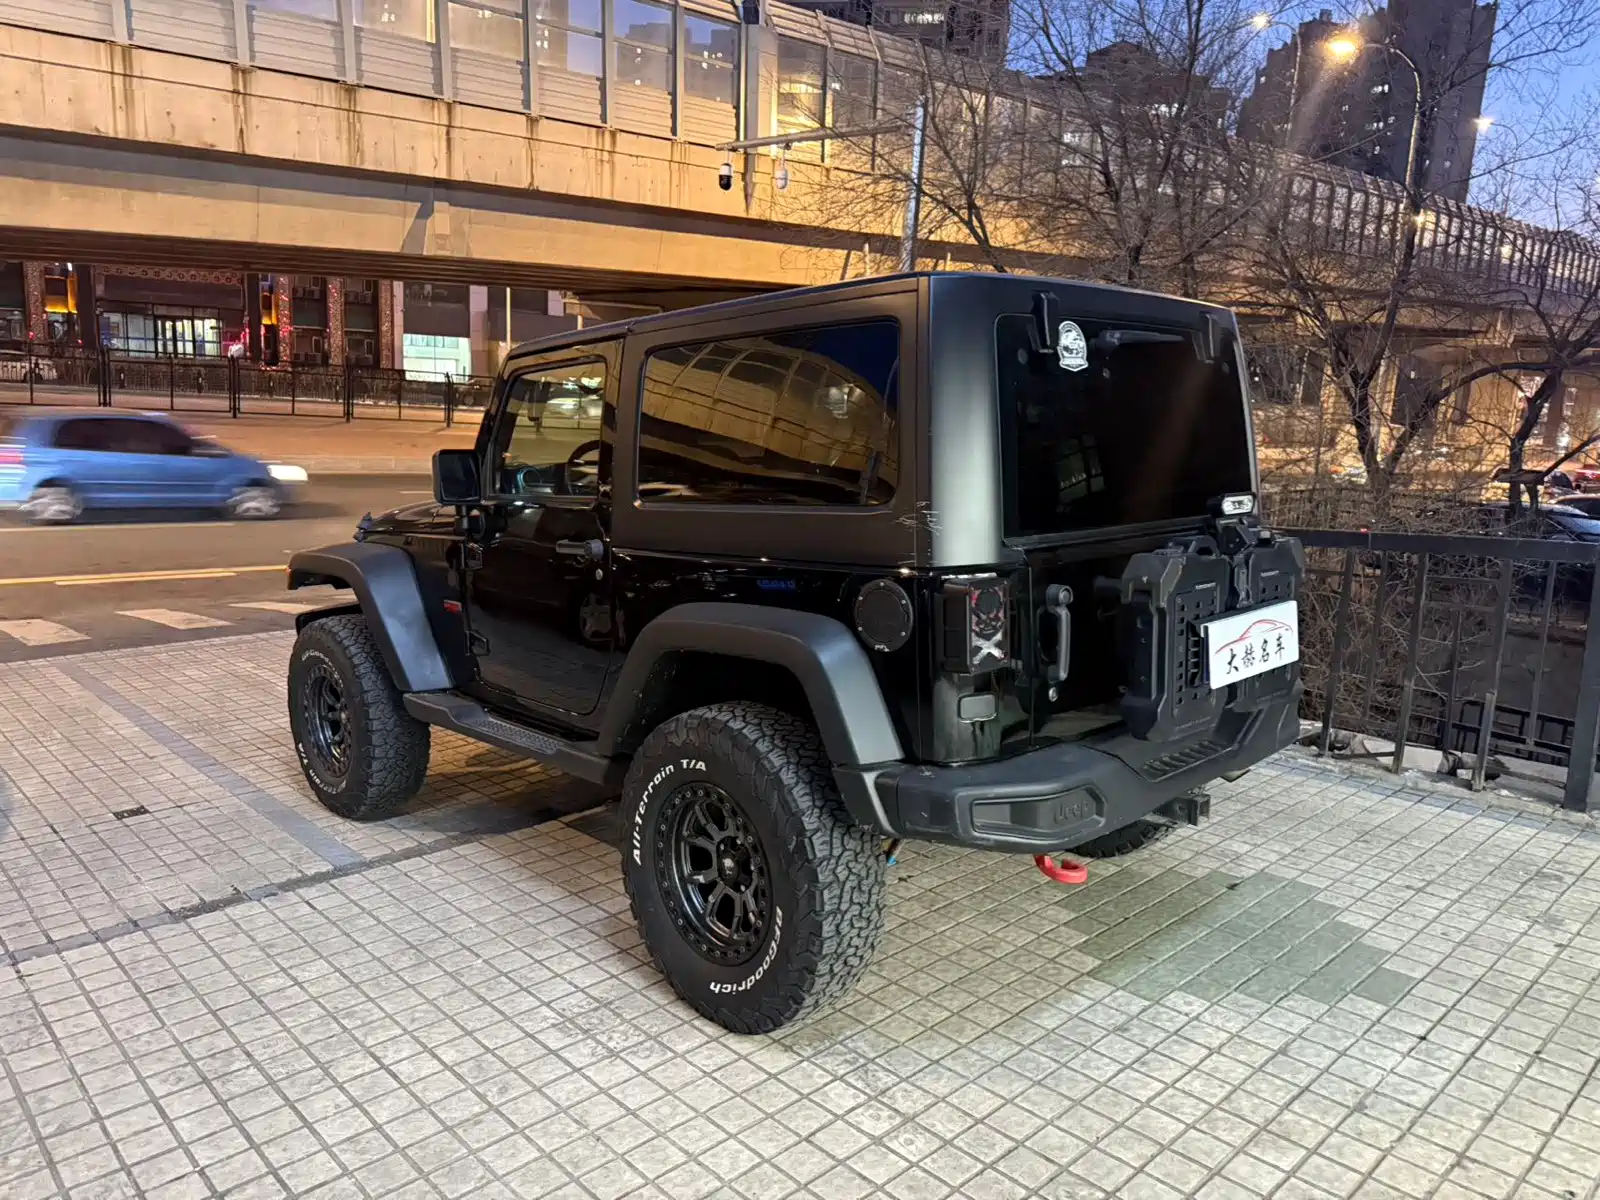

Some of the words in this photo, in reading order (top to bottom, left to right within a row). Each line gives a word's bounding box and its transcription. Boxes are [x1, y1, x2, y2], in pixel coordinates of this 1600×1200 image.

[632, 764, 675, 866] All-Terrain
[680, 759, 707, 772] T/A
[1053, 799, 1091, 825] Jeep
[709, 905, 783, 995] BFGoodrich
